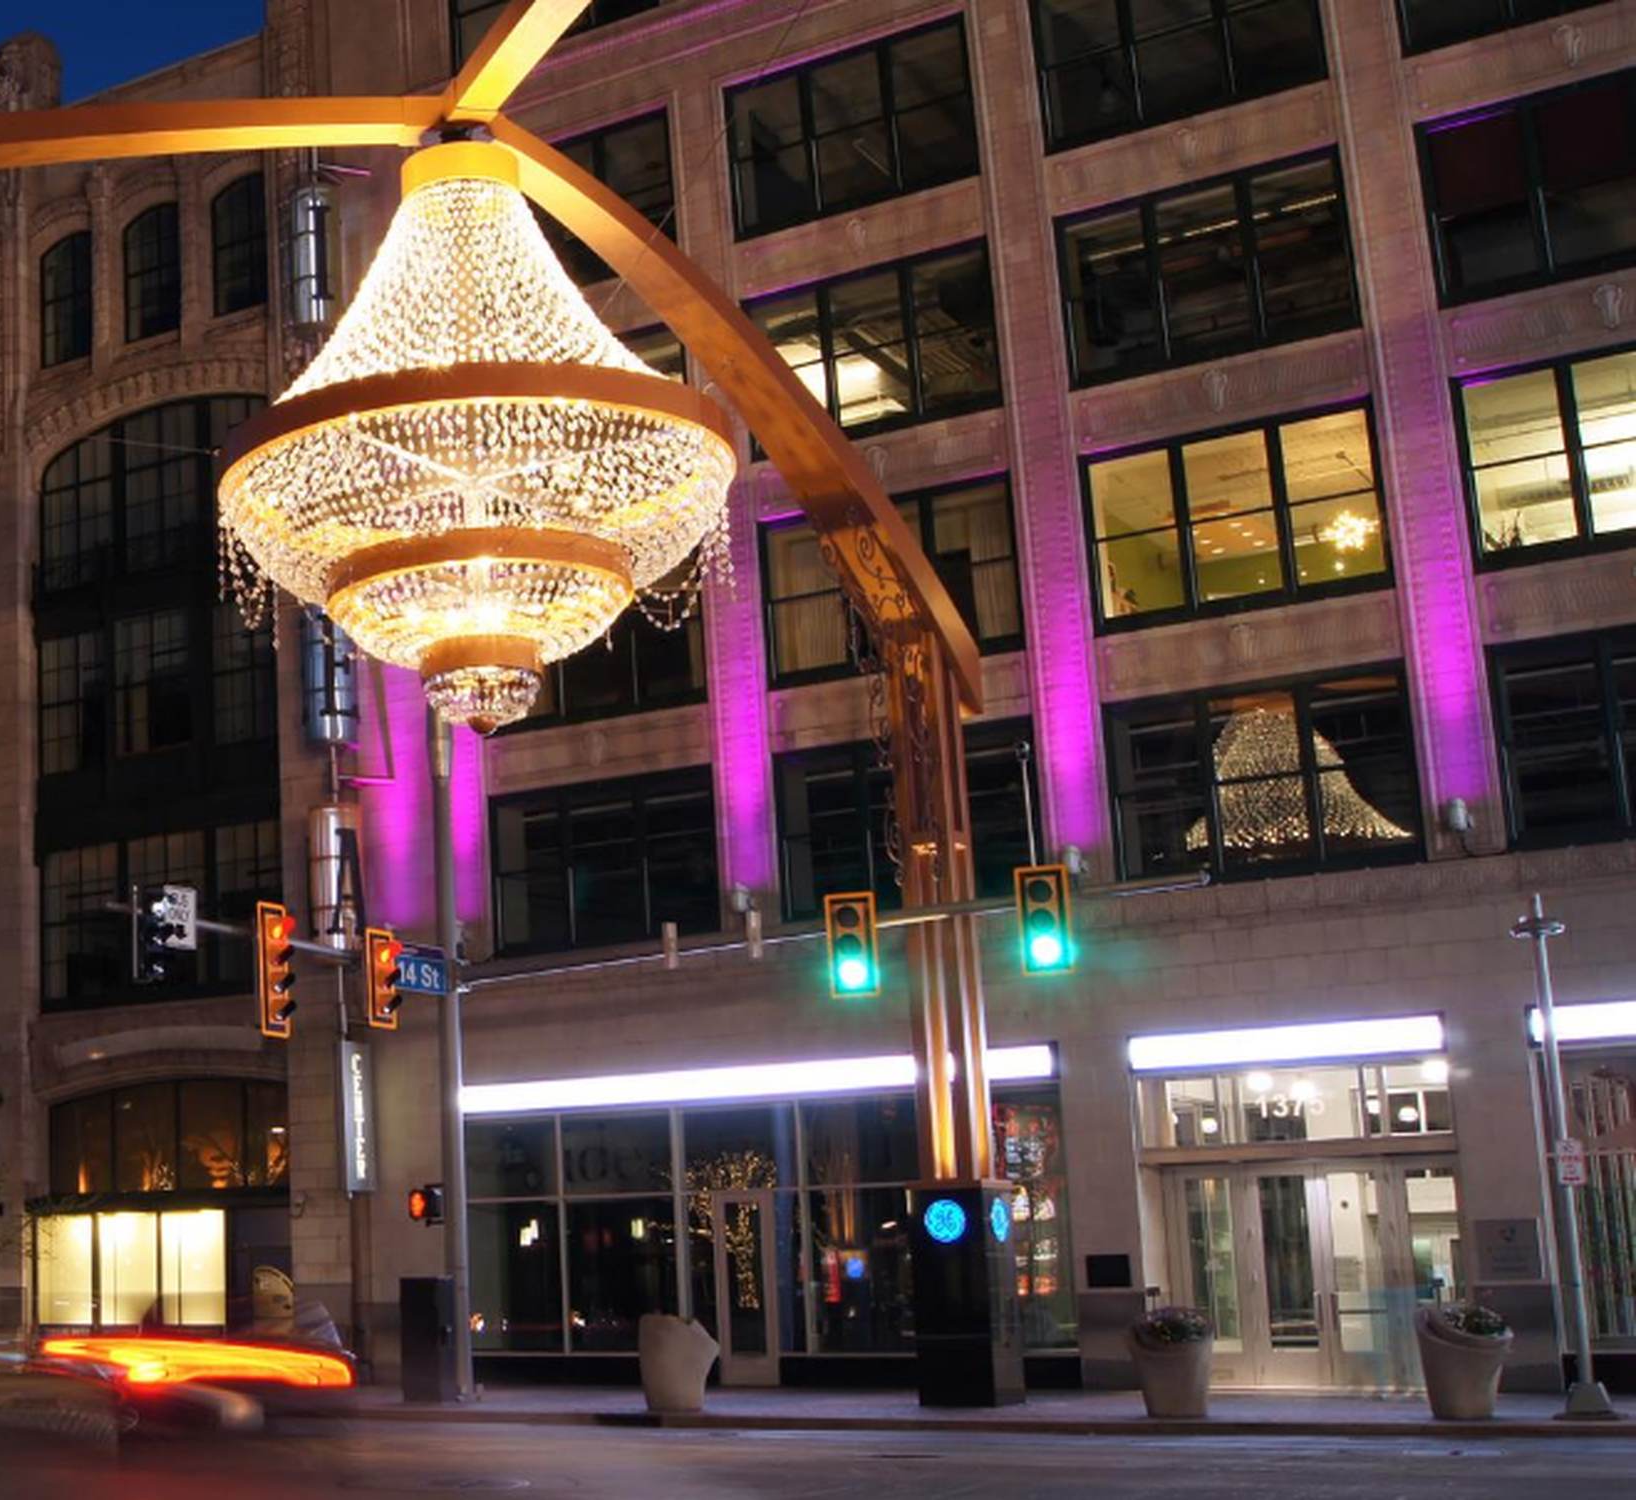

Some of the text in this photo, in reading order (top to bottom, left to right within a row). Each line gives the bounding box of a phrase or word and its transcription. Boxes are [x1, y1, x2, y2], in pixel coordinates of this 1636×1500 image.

[397, 960, 441, 990] 14 St
[1254, 1093, 1326, 1119] 1375
